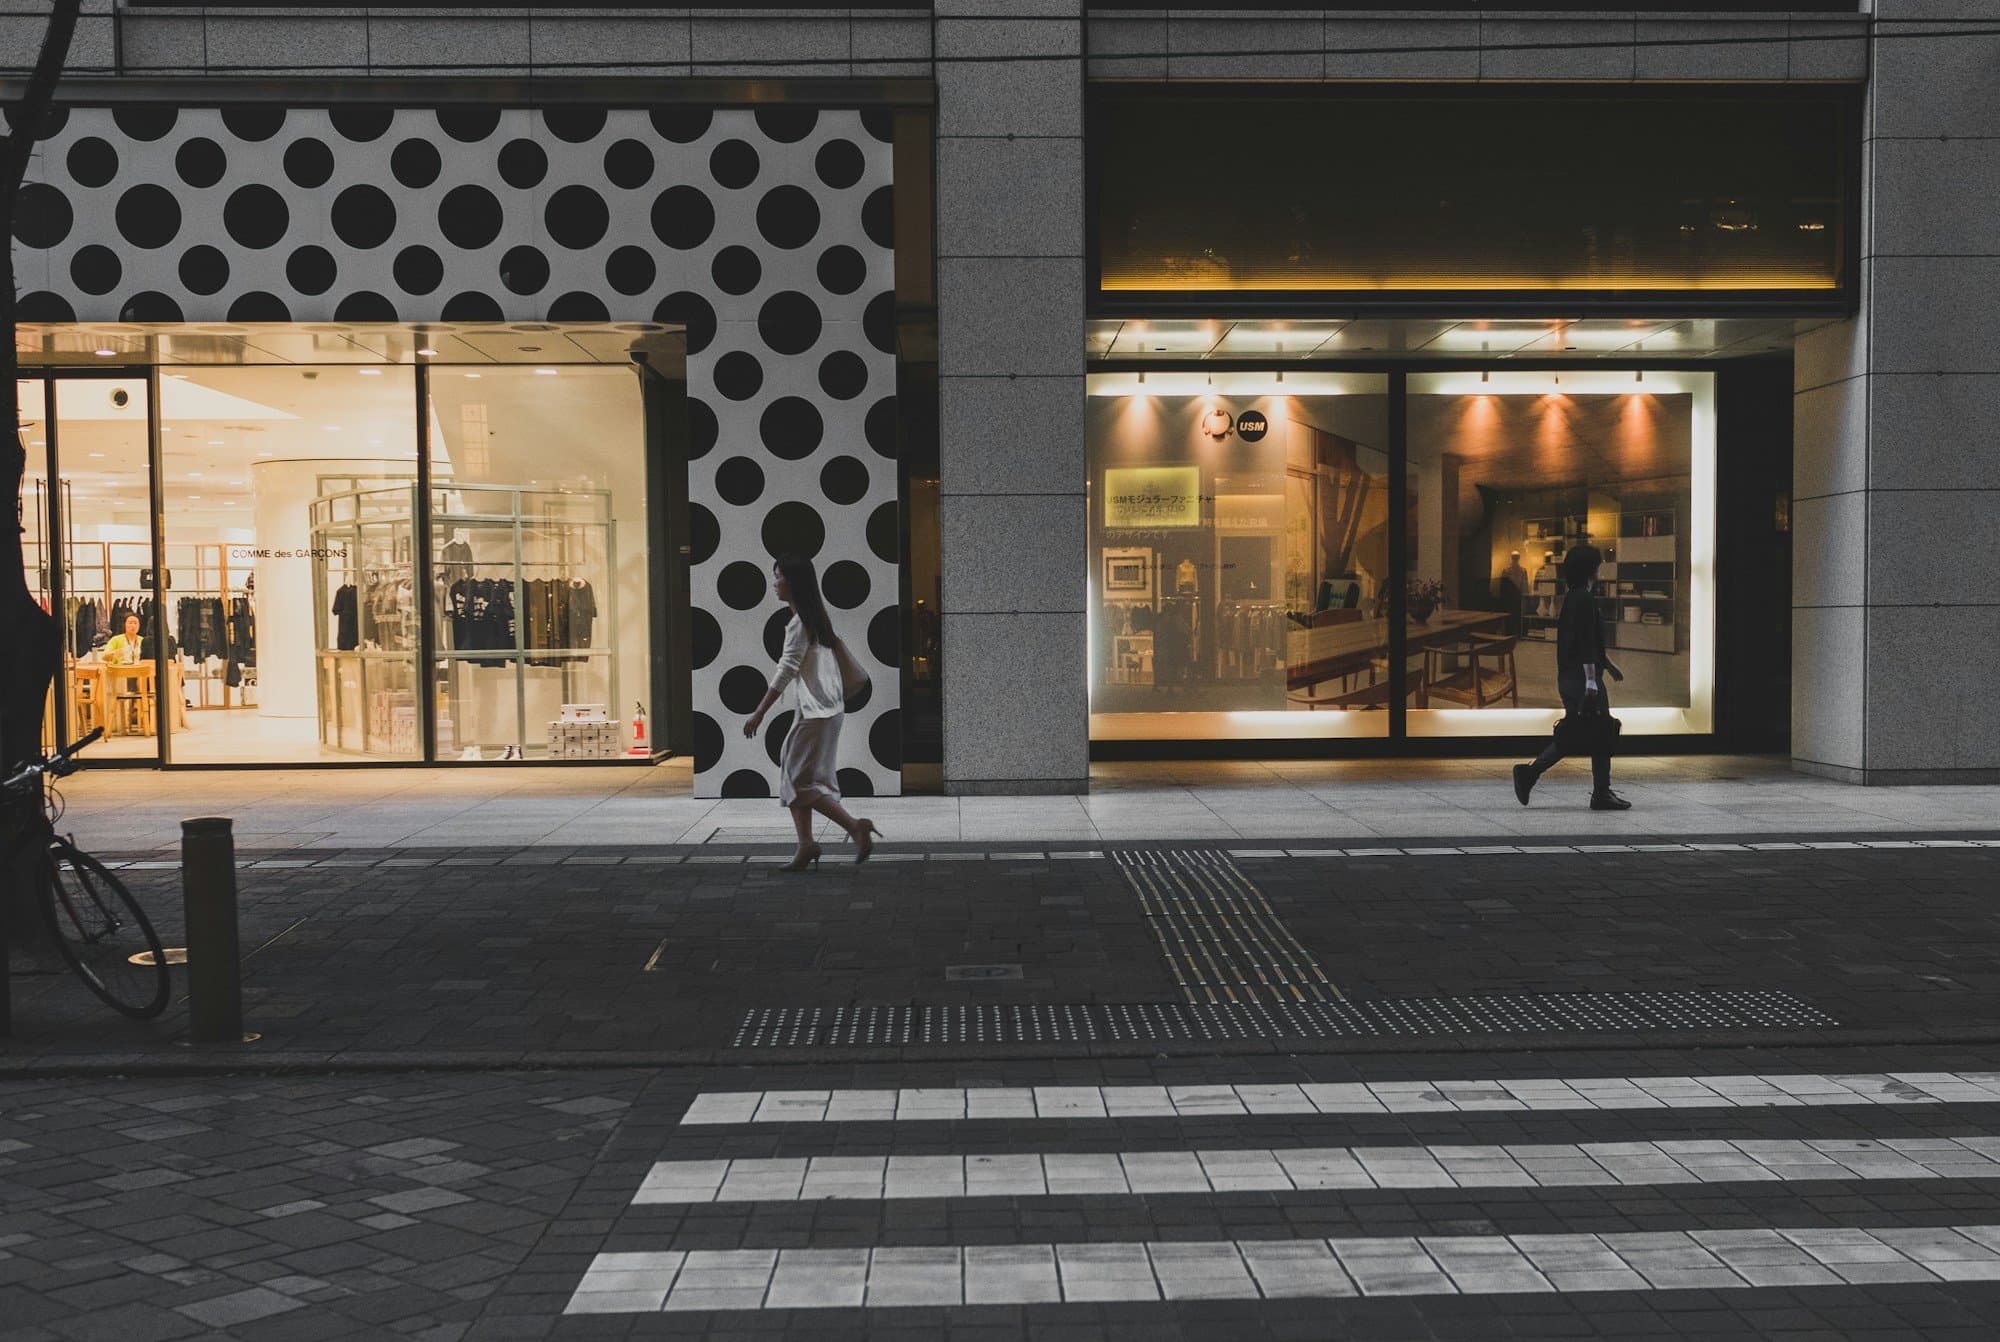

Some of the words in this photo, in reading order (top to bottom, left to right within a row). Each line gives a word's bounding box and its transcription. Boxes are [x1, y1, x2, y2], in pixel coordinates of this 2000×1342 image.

[1240, 422, 1265, 431] USM
[231, 549, 271, 558] COMME
[274, 549, 291, 558] des
[295, 549, 348, 561] GARÇONS
